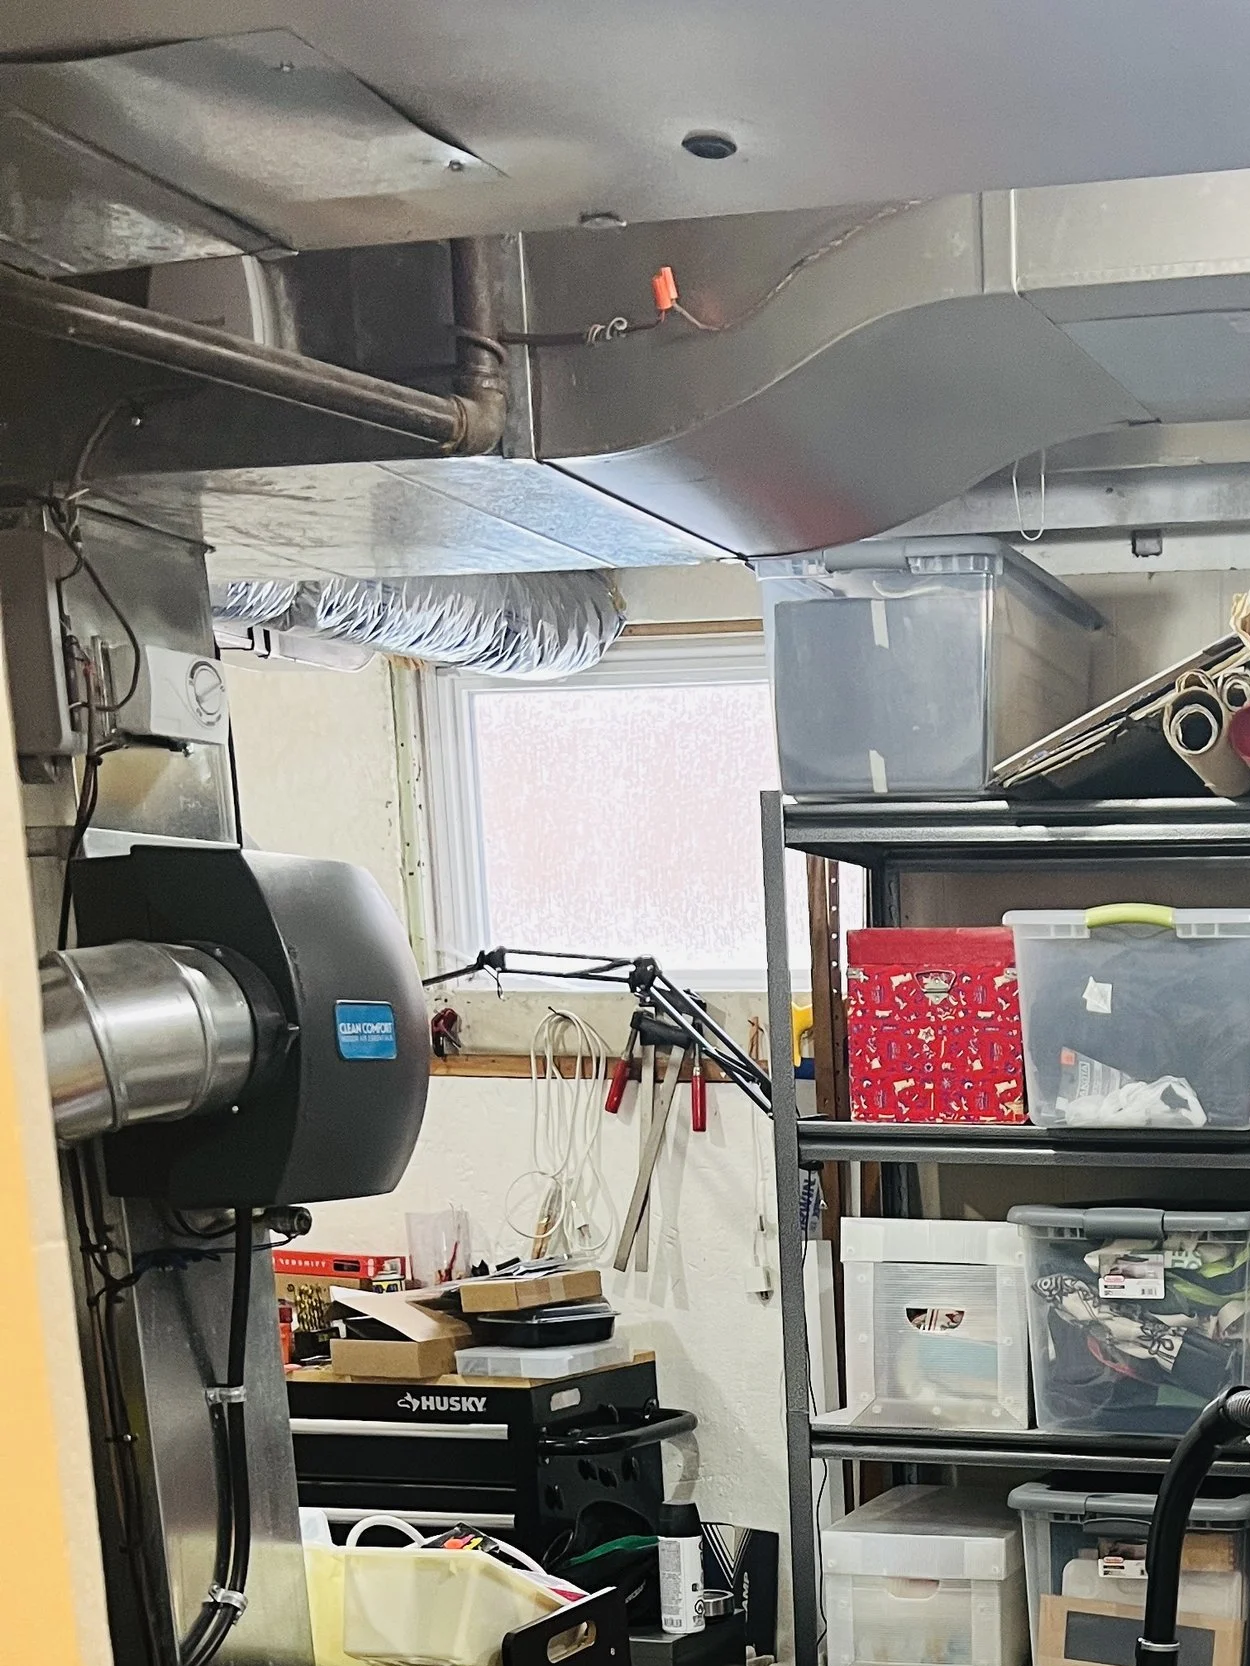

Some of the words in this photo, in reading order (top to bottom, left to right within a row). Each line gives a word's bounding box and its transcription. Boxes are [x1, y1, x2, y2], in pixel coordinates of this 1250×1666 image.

[339, 1022, 362, 1035] CLEAN
[362, 1022, 393, 1034] COMFORT
[421, 1395, 487, 1412] HUSKY
